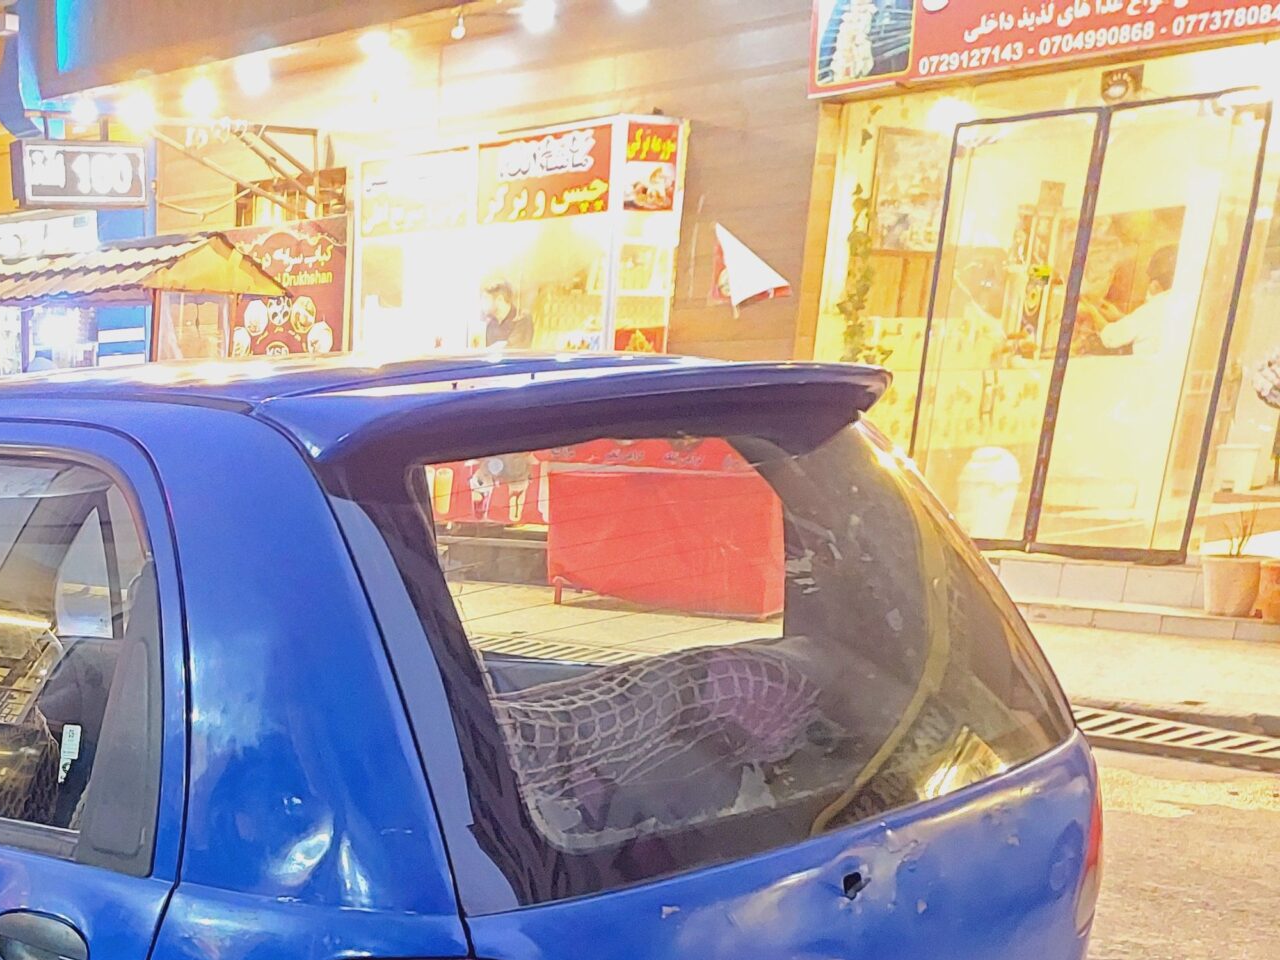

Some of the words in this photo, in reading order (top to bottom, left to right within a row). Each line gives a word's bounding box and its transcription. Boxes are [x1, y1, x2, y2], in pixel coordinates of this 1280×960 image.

[963, 12, 1014, 43] داخلی
[919, 41, 1024, 75] 0729127143
[1039, 21, 1156, 56] 0704990868
[550, 179, 608, 214] چپس
